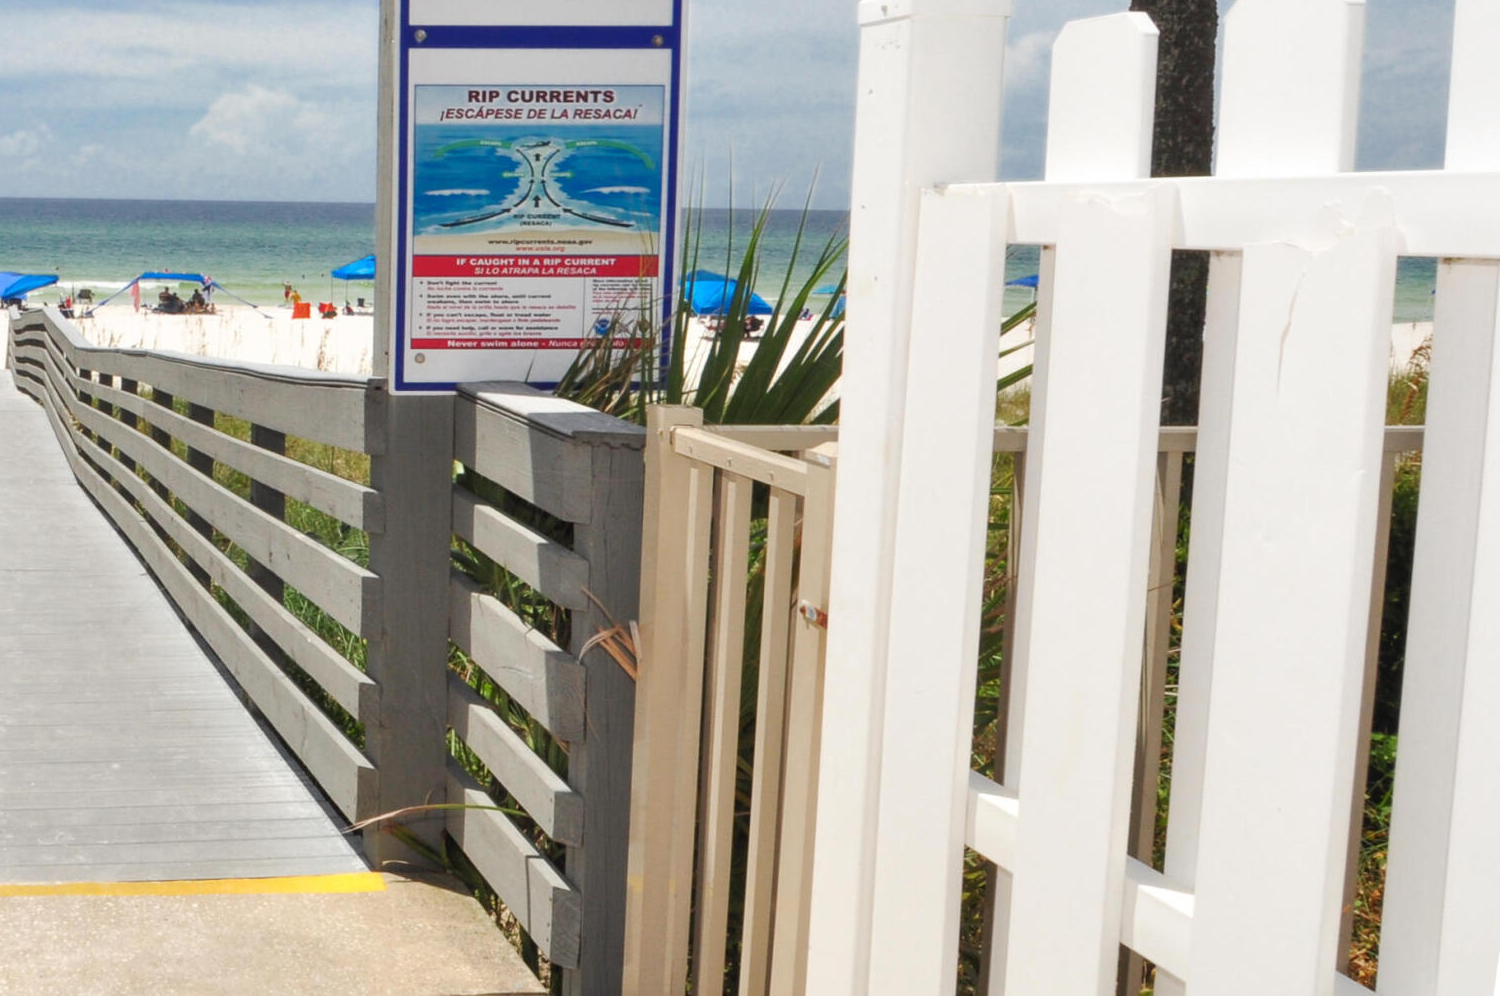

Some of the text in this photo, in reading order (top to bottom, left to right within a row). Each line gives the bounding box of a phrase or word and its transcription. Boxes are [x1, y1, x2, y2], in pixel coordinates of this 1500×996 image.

[468, 90, 615, 103] RIP CURRENTS
[527, 106, 547, 120] DE
[551, 106, 569, 120] LA
[573, 106, 638, 120] RESACA!
[456, 258, 617, 266] IF CAUGHT IN A RIP CURRENT
[501, 267, 540, 276] ATRAPA
[541, 267, 555, 276] LA
[556, 267, 597, 276] RESACA
[447, 339, 478, 348] Never
[481, 339, 508, 348] swim
[511, 339, 539, 348] alone
